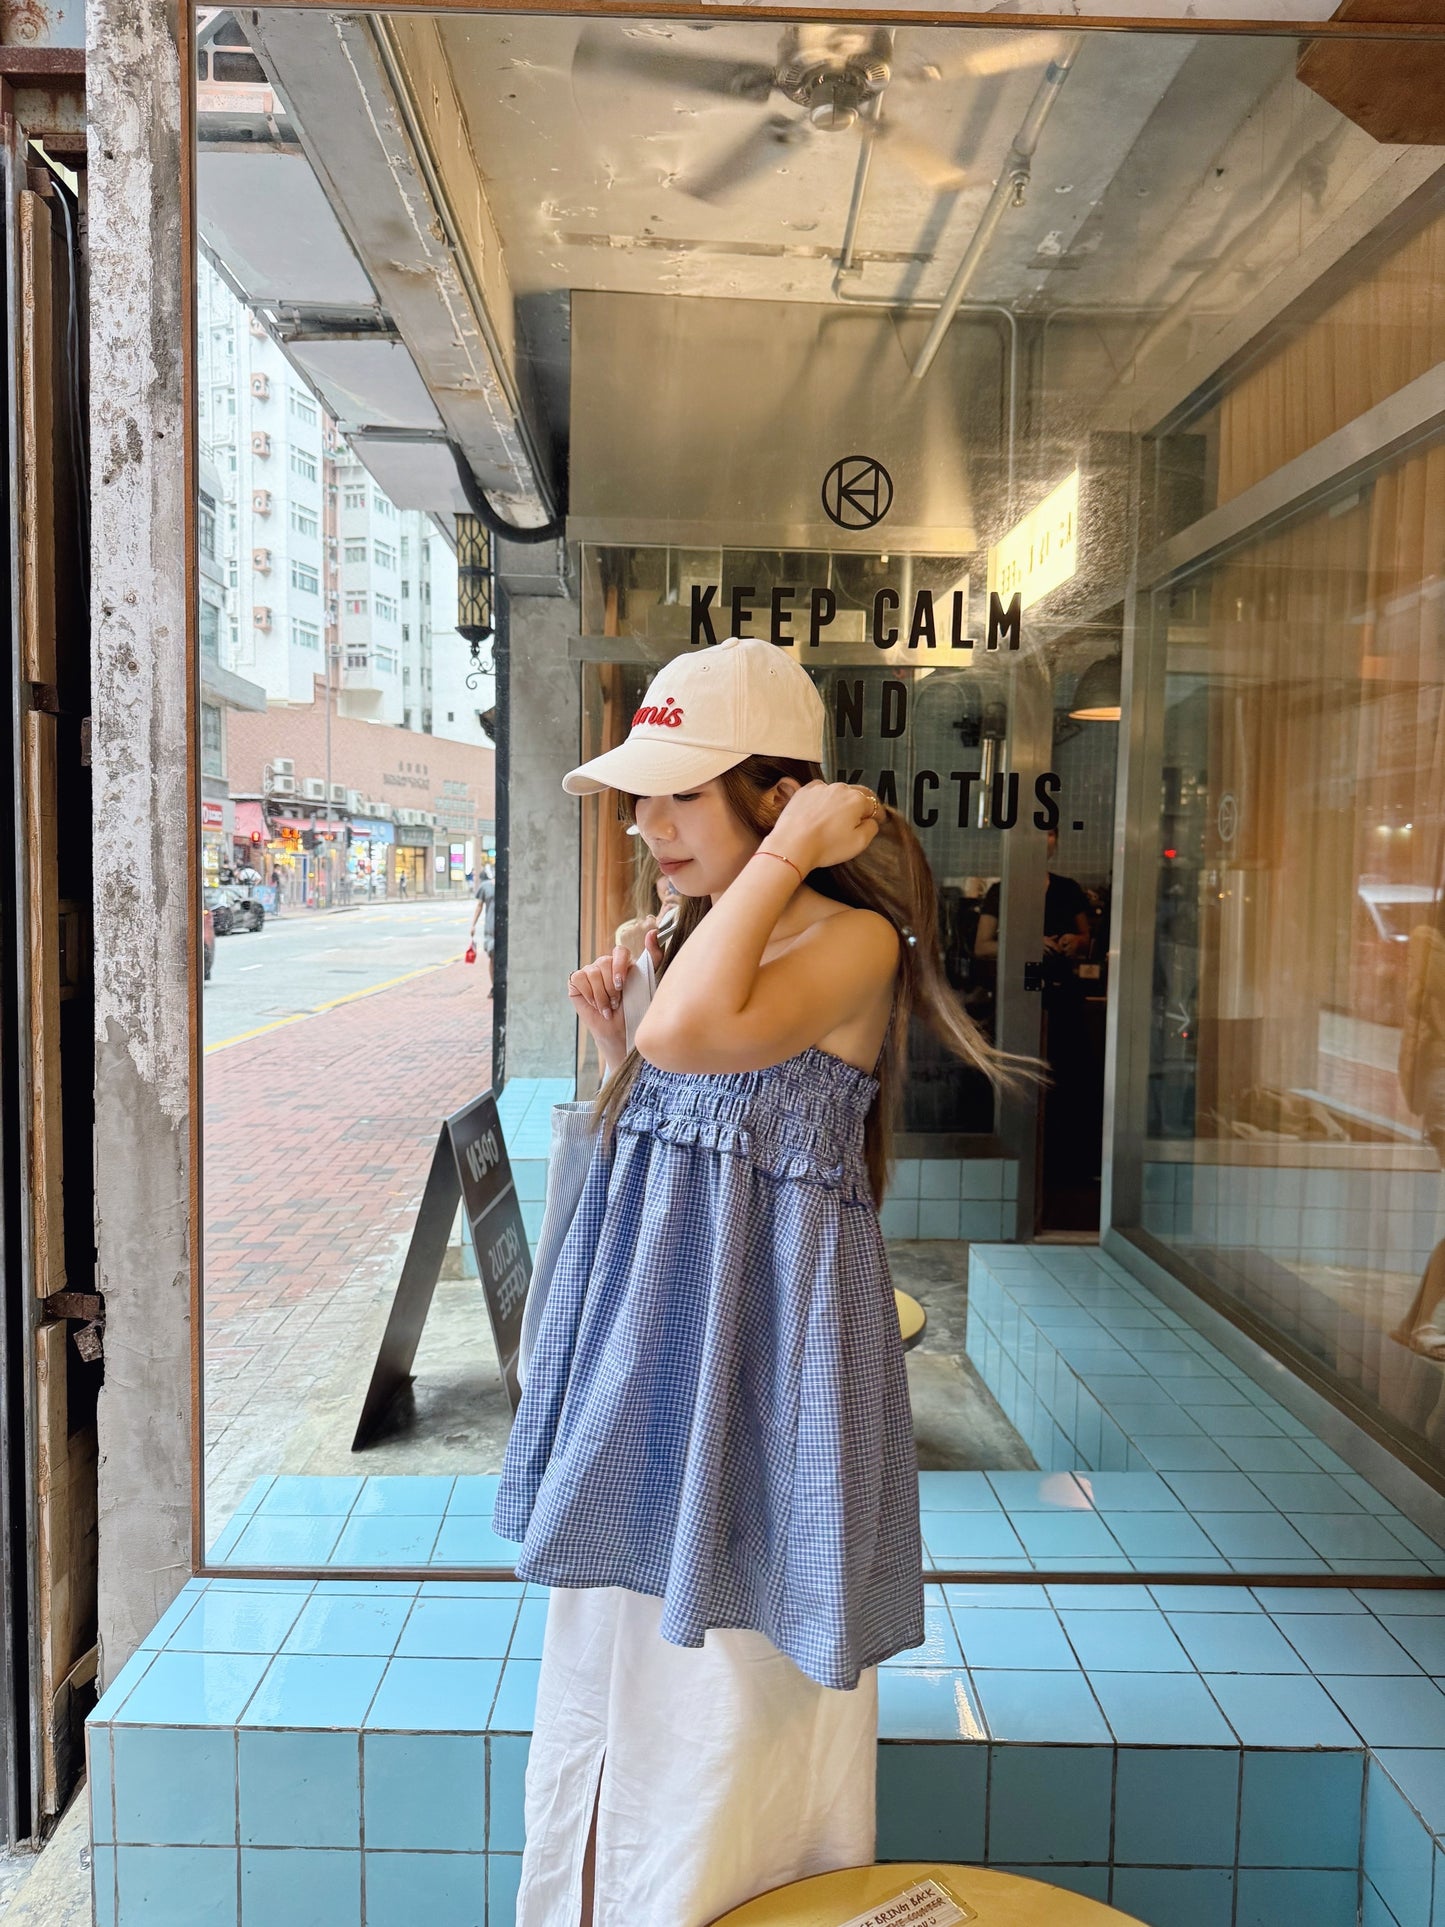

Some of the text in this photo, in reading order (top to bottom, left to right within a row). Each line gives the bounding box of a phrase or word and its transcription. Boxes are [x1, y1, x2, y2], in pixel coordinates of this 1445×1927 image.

[690, 585, 1022, 650] KEEP CALM
[836, 680, 907, 738] ND
[837, 769, 1084, 830] ACTUS.
[874, 1903, 910, 1925] BRING
[909, 1888, 936, 1907] BACK
[907, 1897, 947, 1922] COUNTER
